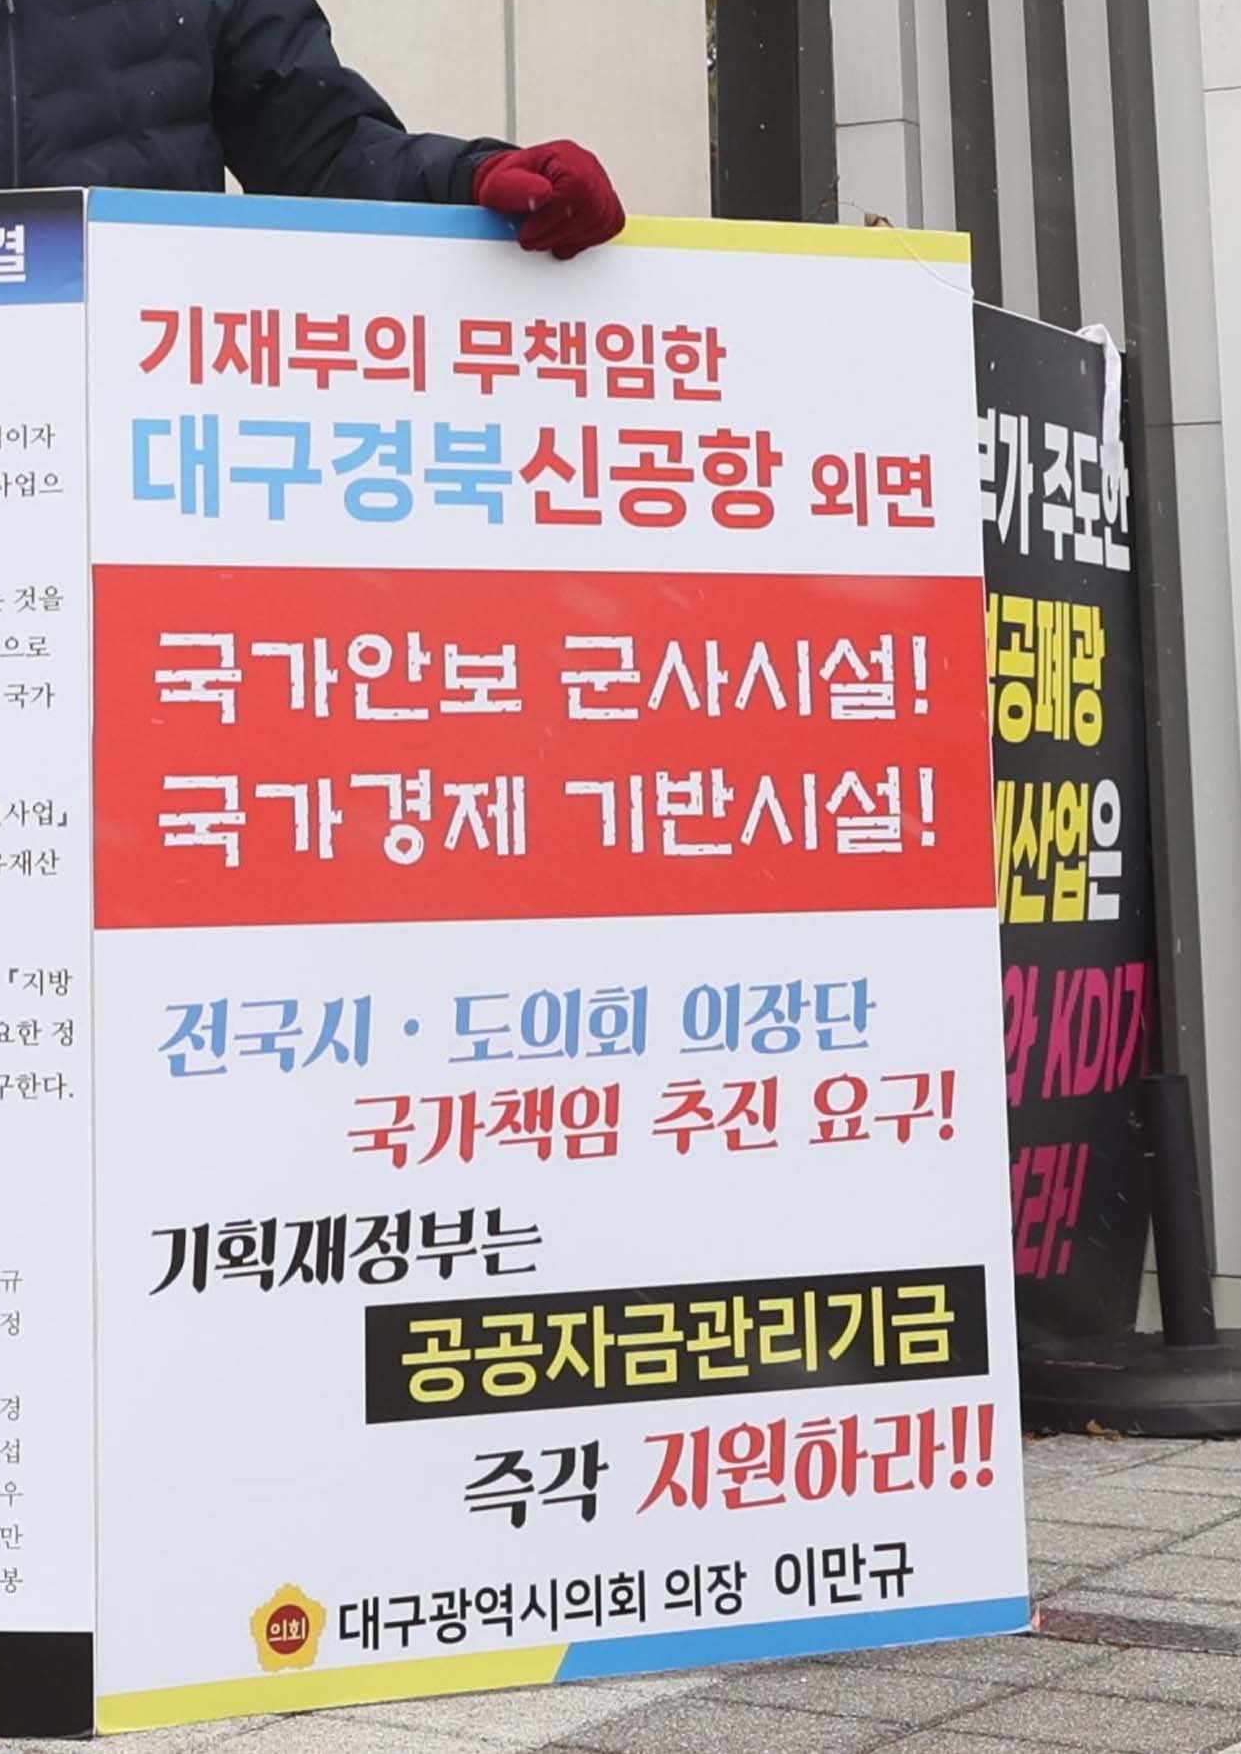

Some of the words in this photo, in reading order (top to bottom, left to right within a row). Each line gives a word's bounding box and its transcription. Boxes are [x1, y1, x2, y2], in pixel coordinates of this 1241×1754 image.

[139, 305, 427, 393] 기재부의
[451, 317, 728, 403] 무책임한
[133, 414, 784, 531] 대구경북신공항
[809, 451, 937, 529] 외면
[153, 631, 523, 725] 국가안보
[560, 633, 930, 721] 군사시설!
[986, 592, 1106, 747] 공폐광
[157, 768, 527, 868] 국가경제
[564, 765, 936, 857] 기반시설!
[52, 1018, 75, 1048] 정
[680, 977, 877, 1055] 의장단
[346, 1082, 621, 1170] 국가책임
[651, 1074, 779, 1156] 추진
[808, 1069, 956, 1146] 요구!
[147, 1206, 544, 1297] 기획재정부는
[1010, 1142, 1091, 1280] 라!
[400, 1283, 956, 1404] 공공자금관리기금
[462, 1438, 611, 1530] 즉각
[635, 1402, 995, 1515] 지원하라!!
[270, 1617, 306, 1642] 의회
[338, 1568, 647, 1652] 대구광역시의회
[662, 1559, 749, 1619] 의장
[773, 1540, 915, 1608] 이만규
